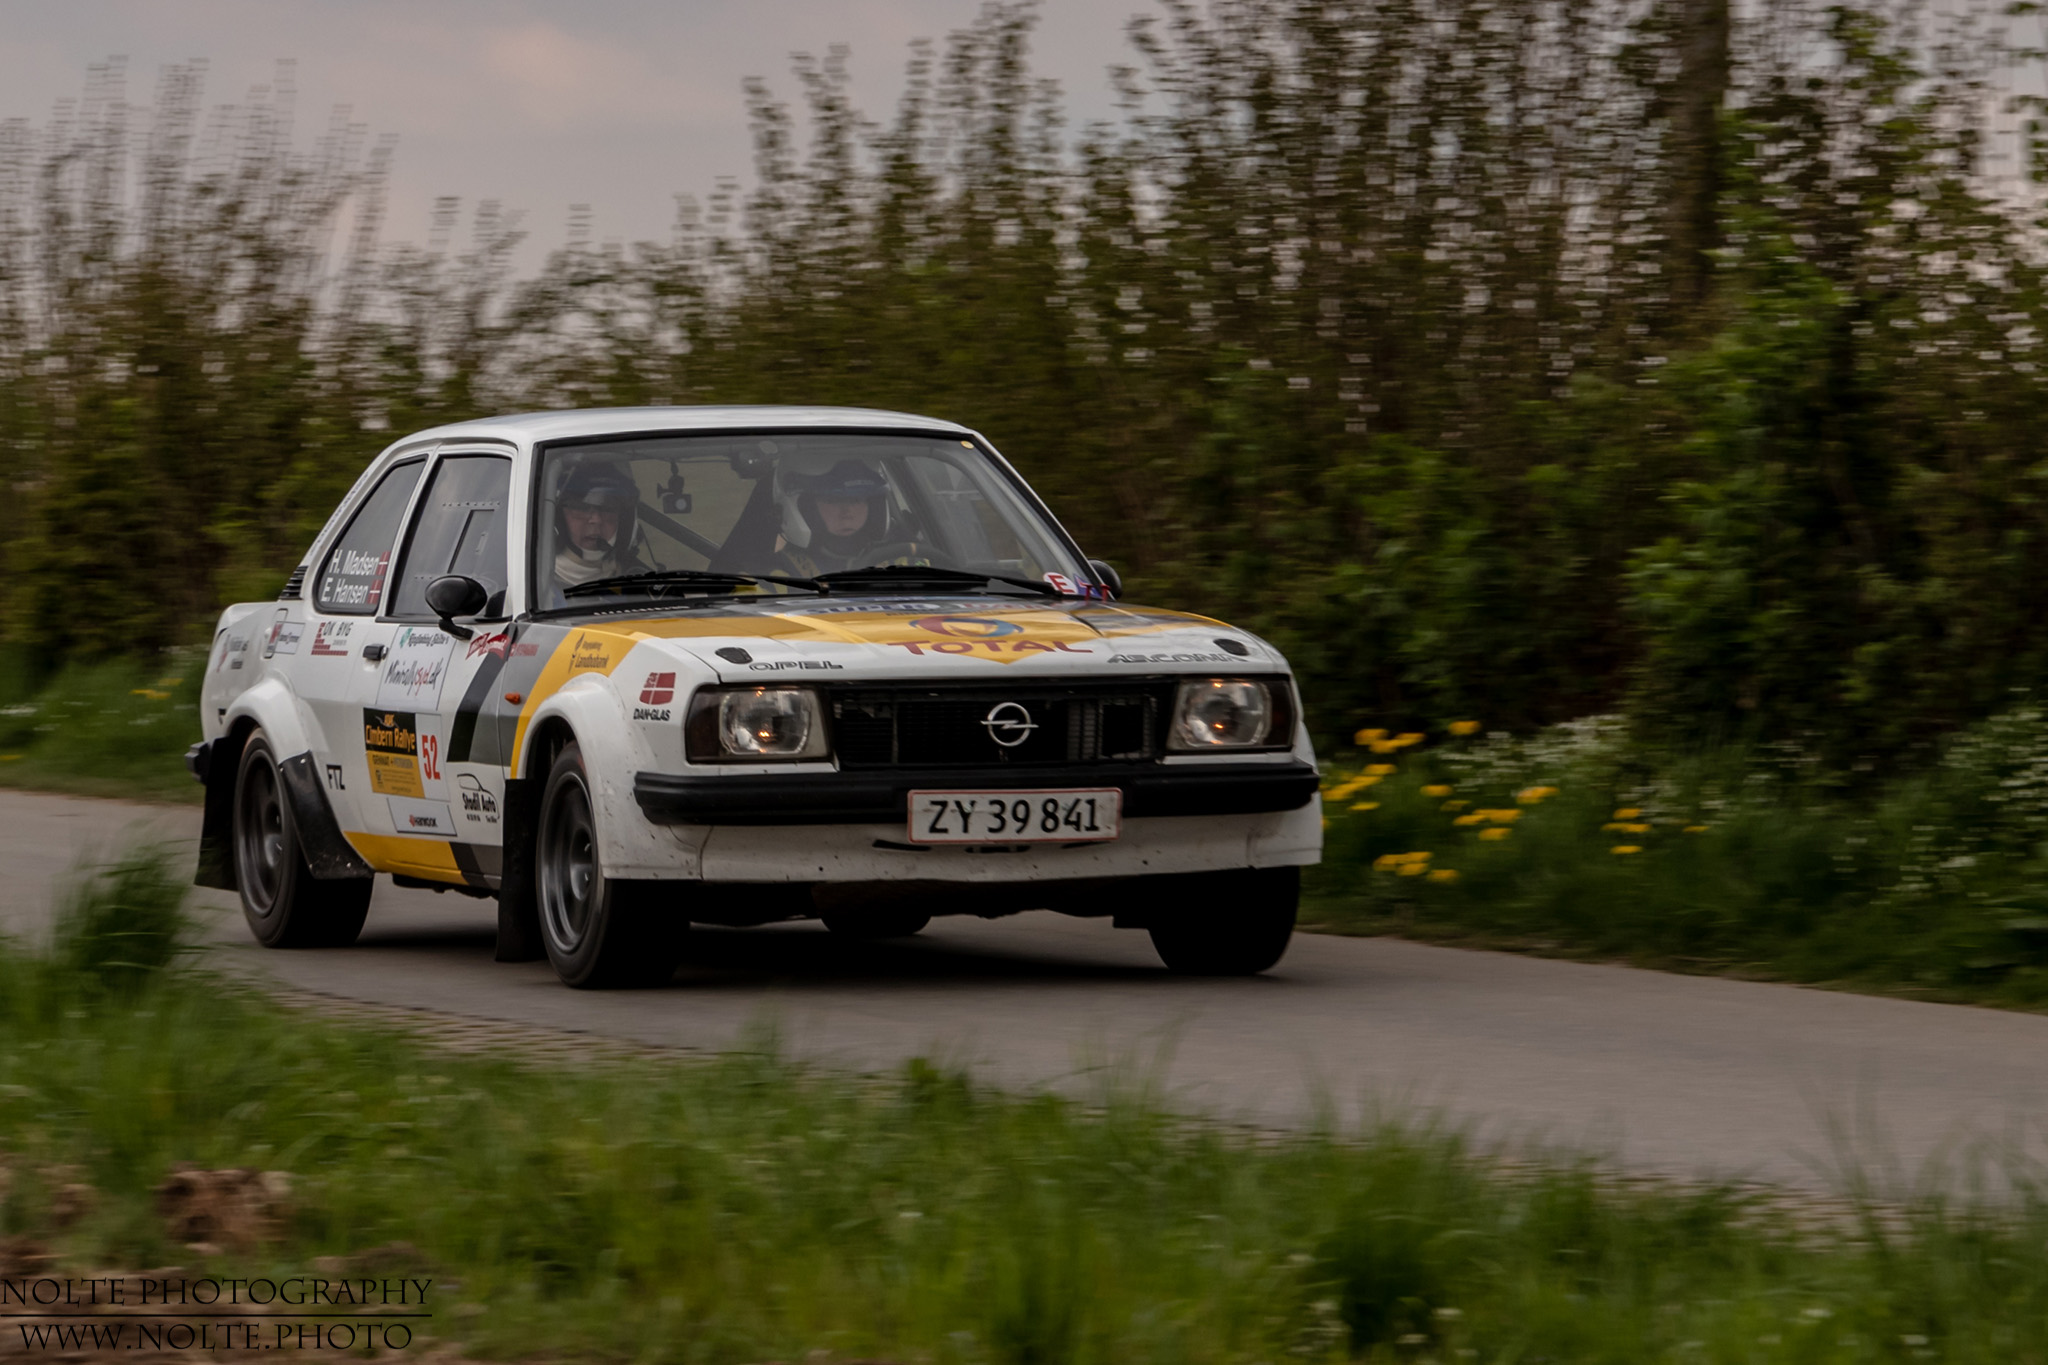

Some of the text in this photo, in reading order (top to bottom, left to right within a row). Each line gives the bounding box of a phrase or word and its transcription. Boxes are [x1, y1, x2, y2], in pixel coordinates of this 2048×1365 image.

[329, 549, 380, 576] H. Madsen
[321, 577, 369, 604] E. Hansen
[886, 640, 1093, 655] TOTAL
[749, 660, 844, 671] OPEL
[633, 708, 671, 721] DAN-GLAS
[394, 727, 416, 753] Rallye
[422, 734, 441, 780] 52
[326, 764, 346, 790] FTZ
[481, 794, 496, 813] Auto
[929, 799, 1100, 834] ZY 39 841
